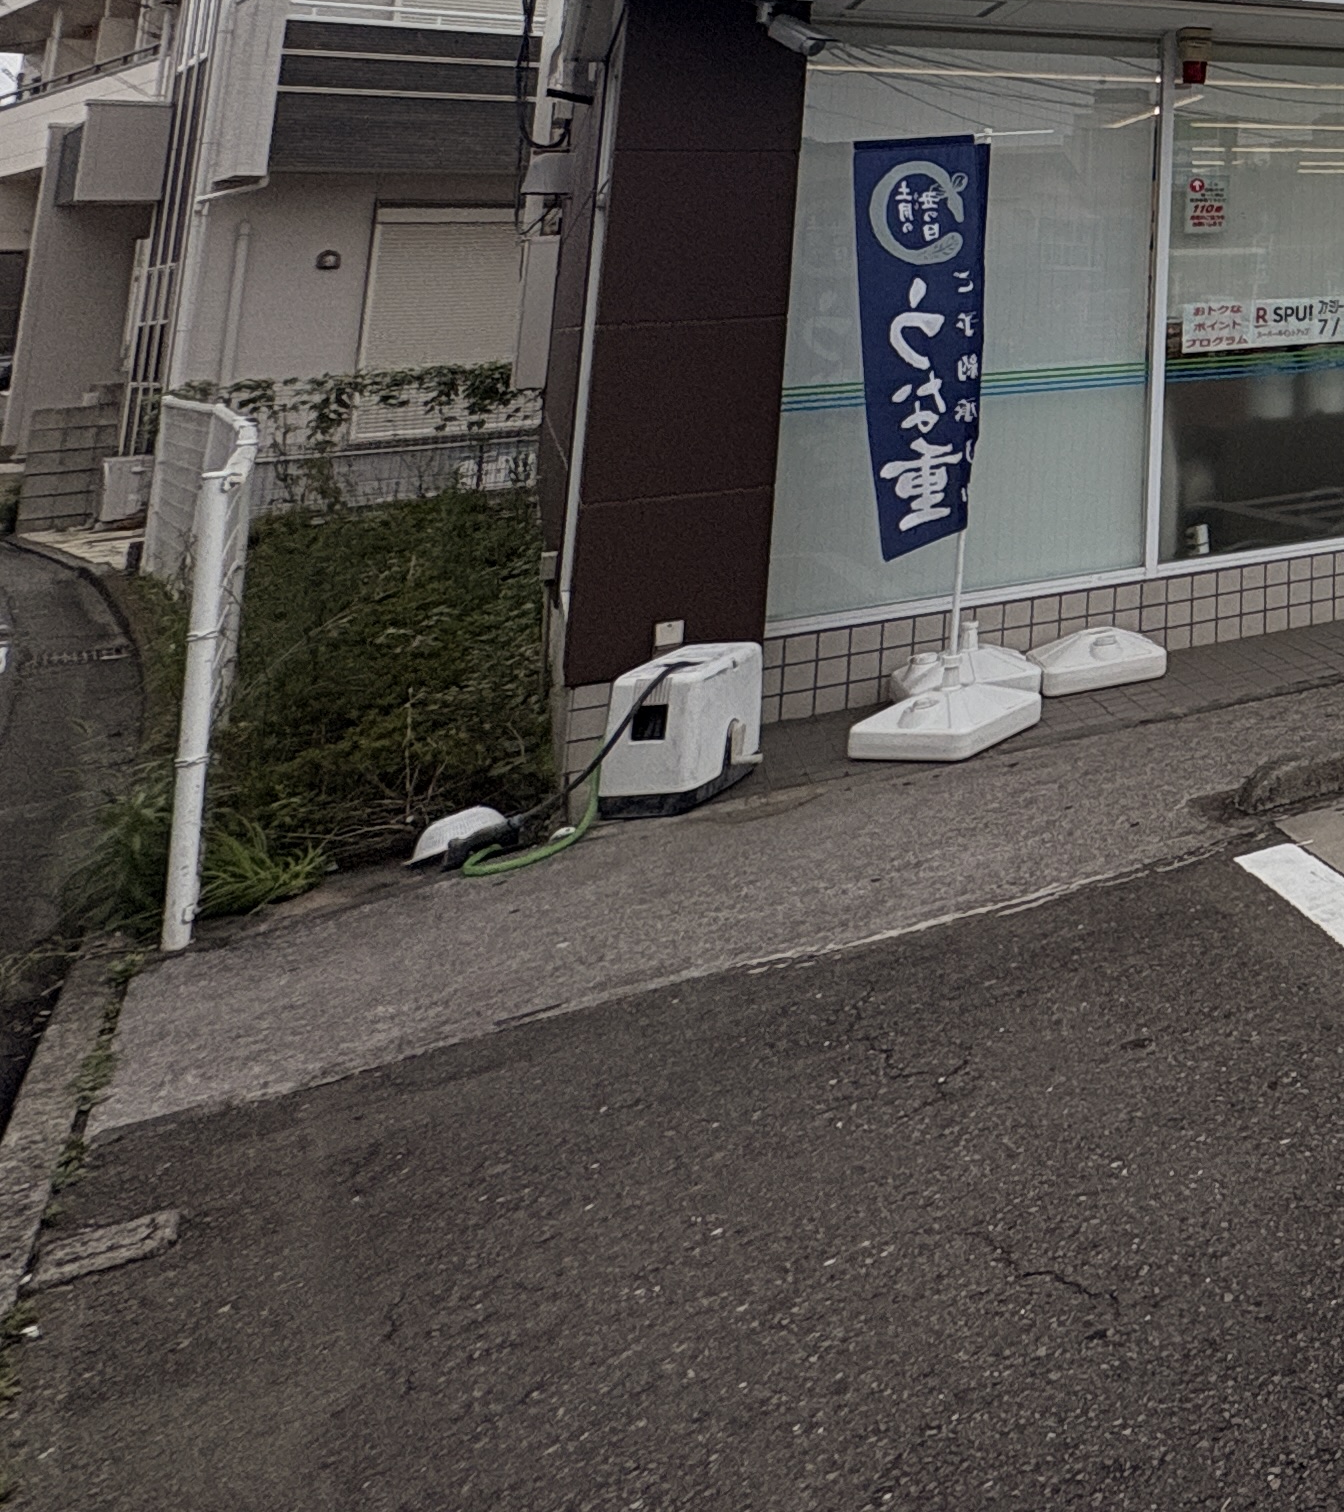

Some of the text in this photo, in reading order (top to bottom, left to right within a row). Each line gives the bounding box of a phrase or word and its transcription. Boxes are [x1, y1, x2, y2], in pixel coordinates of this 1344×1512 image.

[1193, 304, 1242, 317] おトクな
[1273, 303, 1314, 324] SPU!
[1193, 319, 1243, 333] ポイント
[1186, 336, 1249, 350] プログラム
